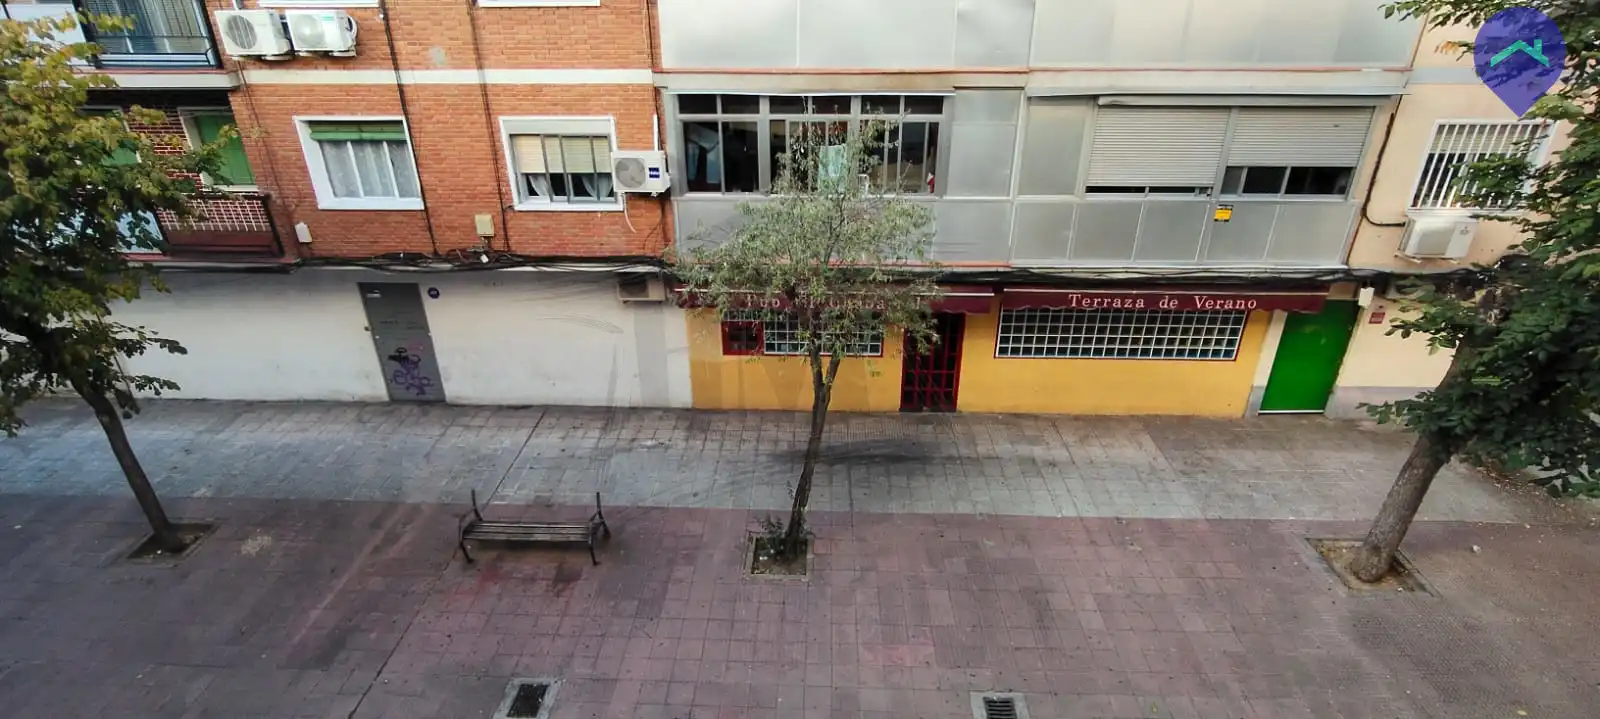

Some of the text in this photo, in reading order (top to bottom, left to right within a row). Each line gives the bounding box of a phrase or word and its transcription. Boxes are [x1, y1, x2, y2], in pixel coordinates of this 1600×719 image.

[1068, 294, 1257, 310] Terraza de Verano
